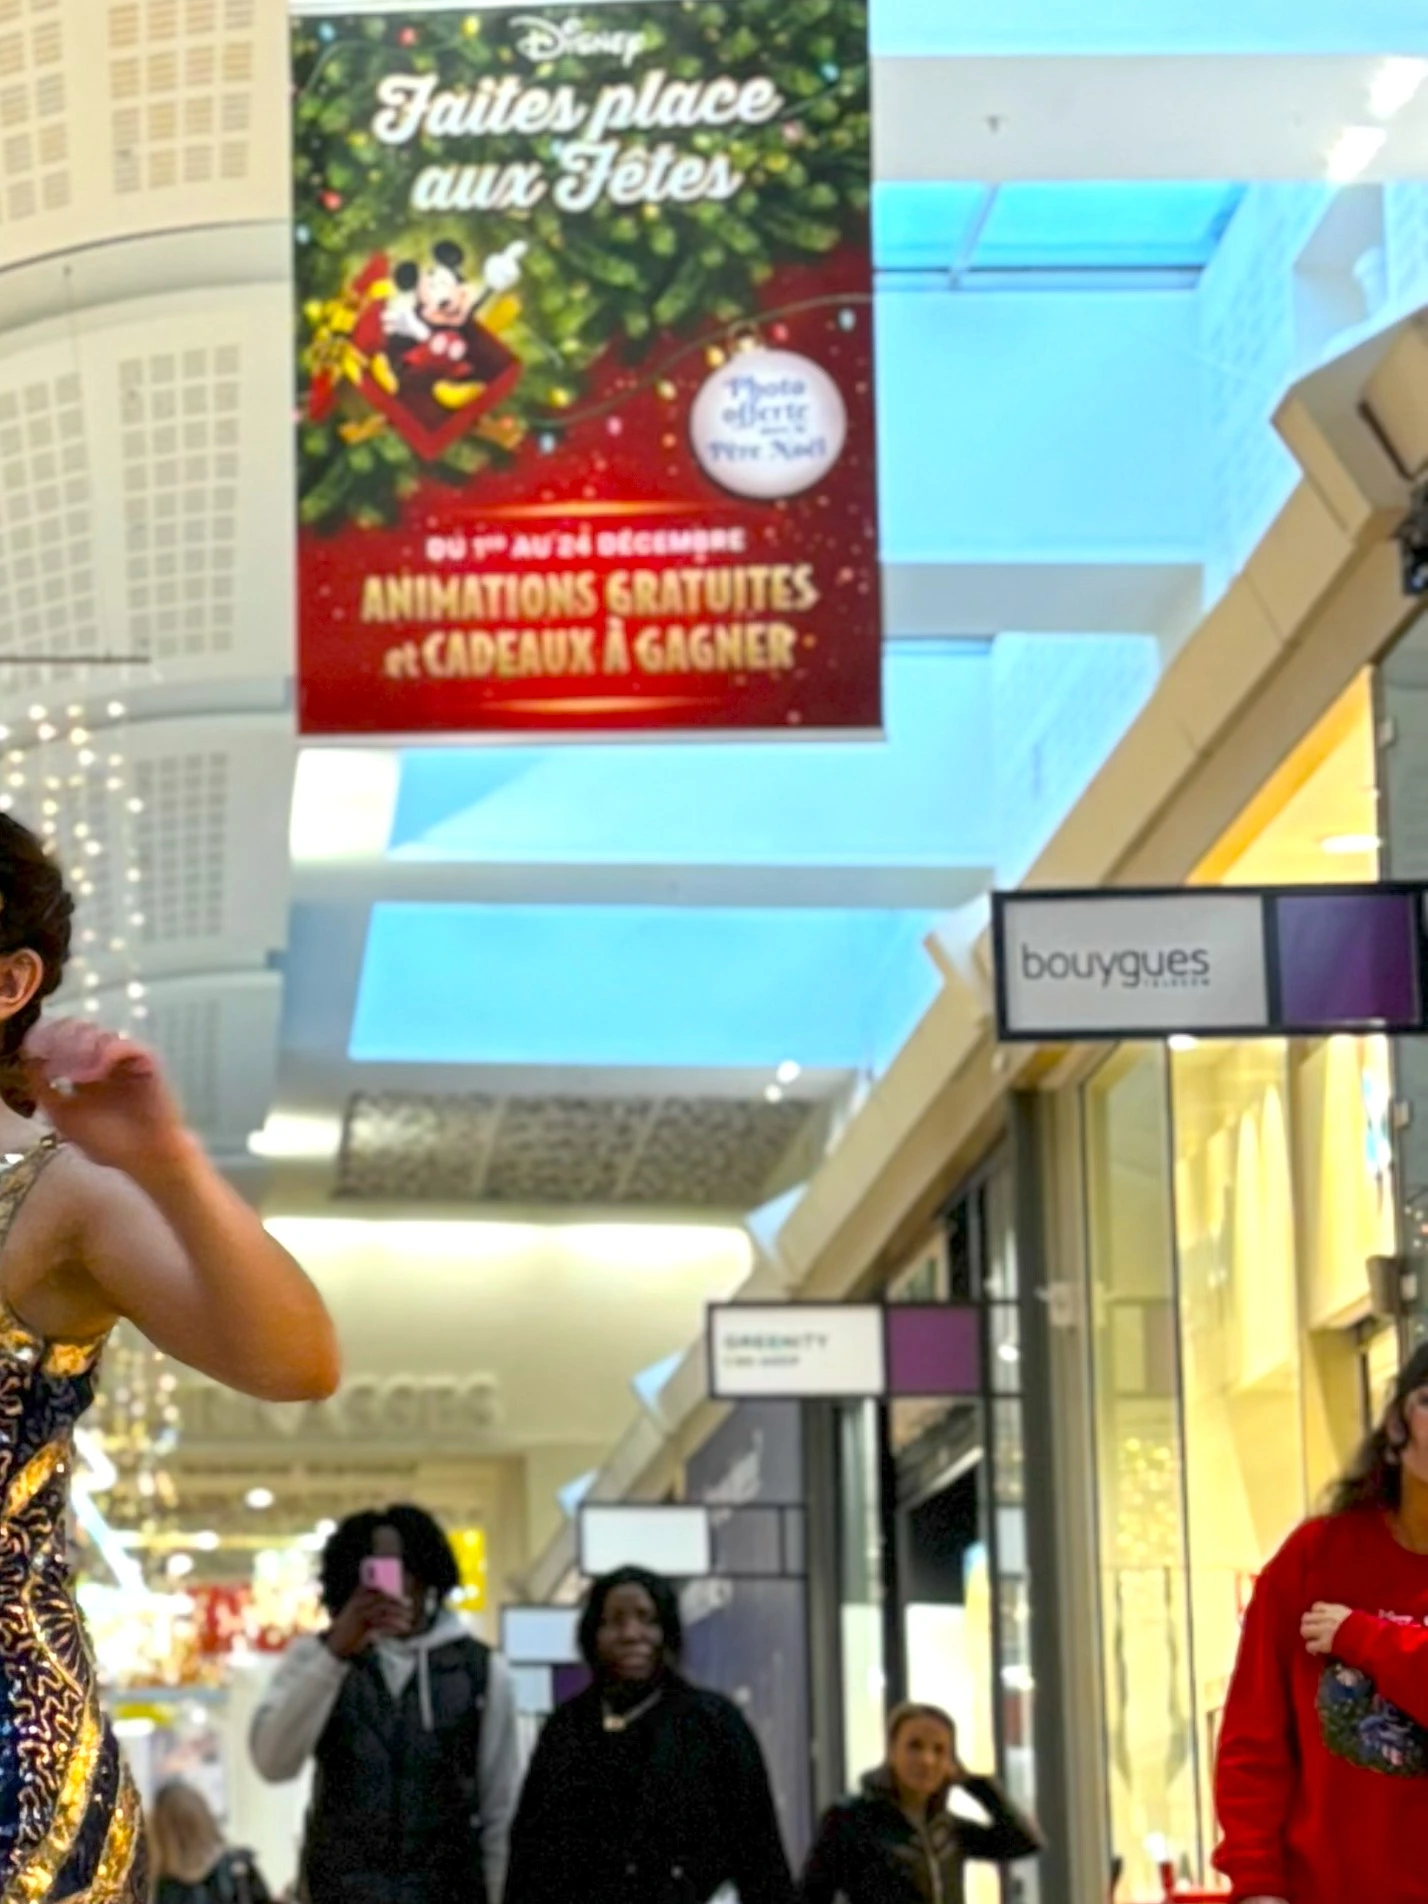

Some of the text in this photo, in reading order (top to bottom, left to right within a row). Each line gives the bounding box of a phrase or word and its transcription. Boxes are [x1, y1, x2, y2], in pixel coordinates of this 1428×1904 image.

[372, 69, 783, 146] Faites place
[411, 140, 744, 213] aux Fêtes
[425, 532, 467, 563] DU
[510, 533, 554, 560] AU
[596, 526, 749, 557] DÉCEMBRE
[361, 563, 818, 624] ANIMATIONS GRATUITES
[385, 616, 797, 679] et CADEAUX À GAGNER
[1020, 941, 1212, 989] bouygues
